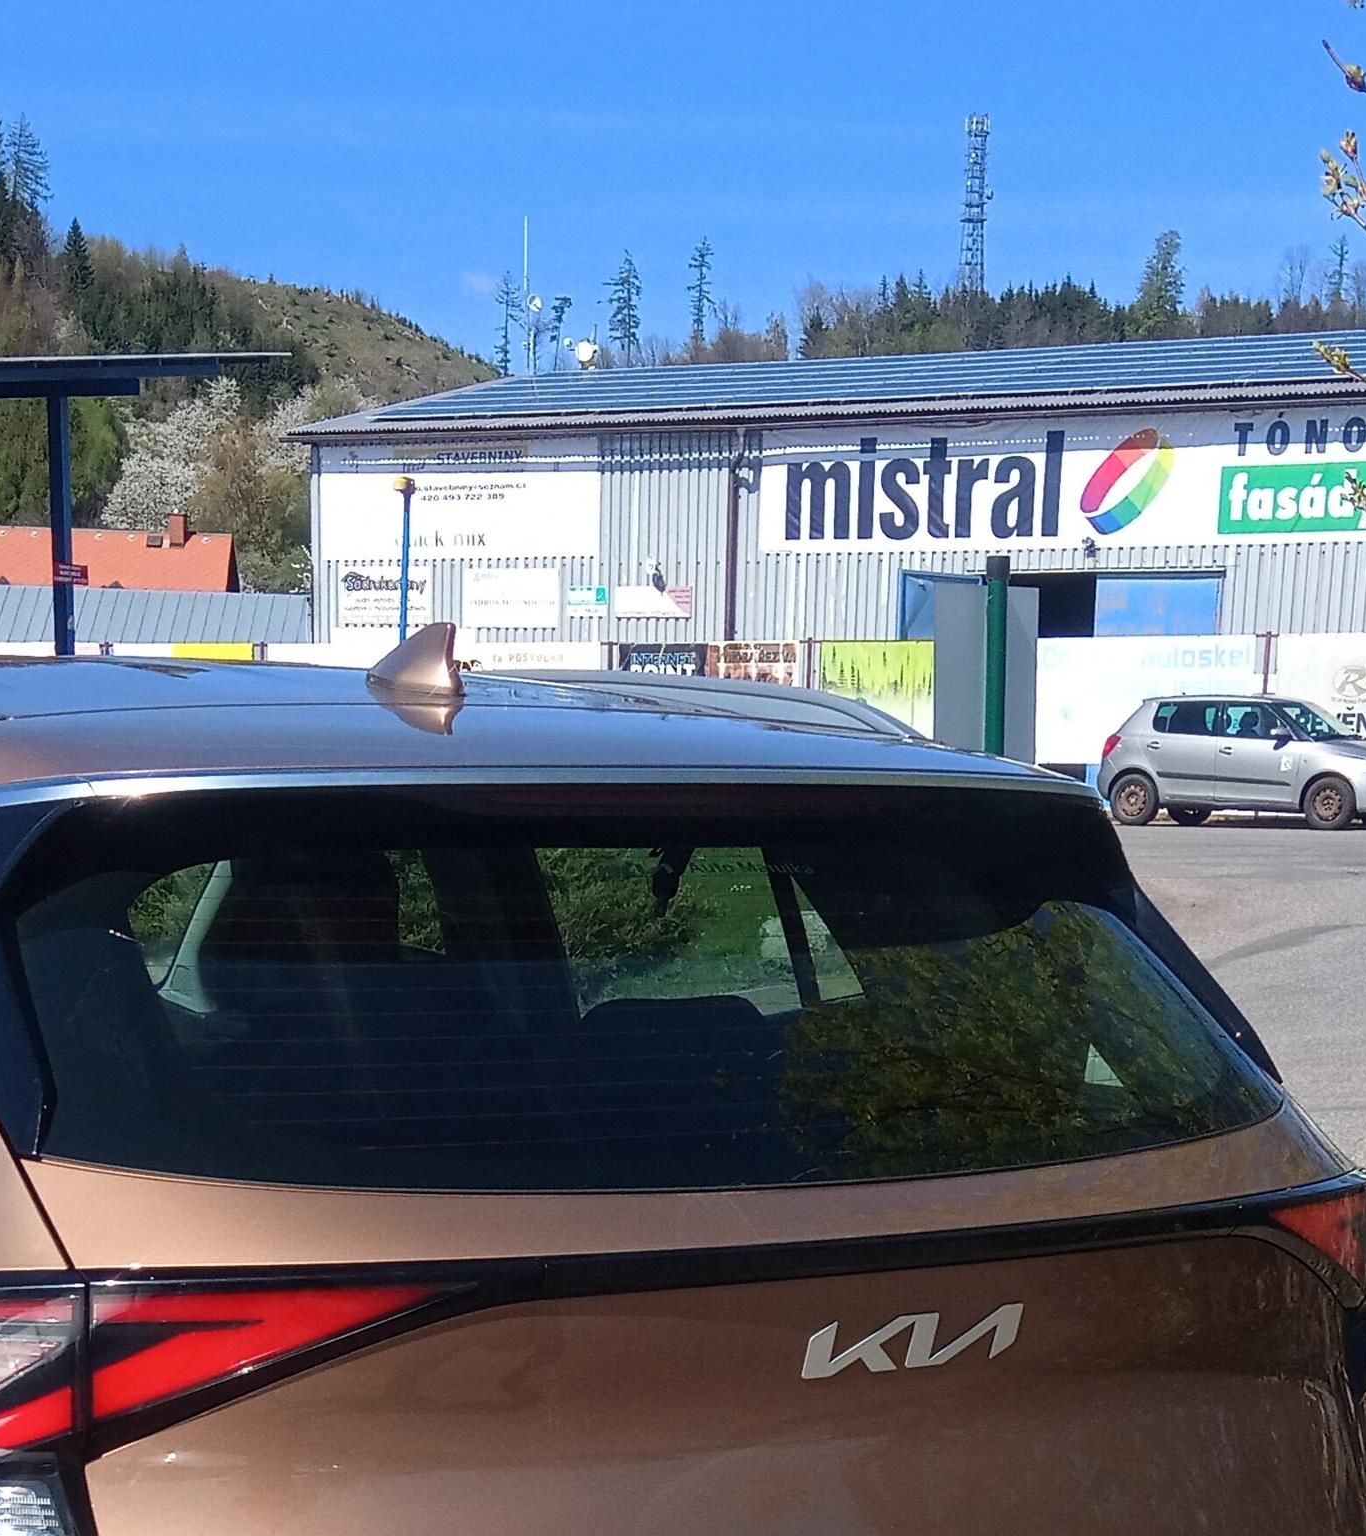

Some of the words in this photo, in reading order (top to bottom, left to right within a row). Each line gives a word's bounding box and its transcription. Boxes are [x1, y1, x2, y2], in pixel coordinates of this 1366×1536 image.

[785, 431, 1065, 540] mistral
[630, 652, 696, 666] INTERNET
[801, 1303, 1024, 1380] KIA
